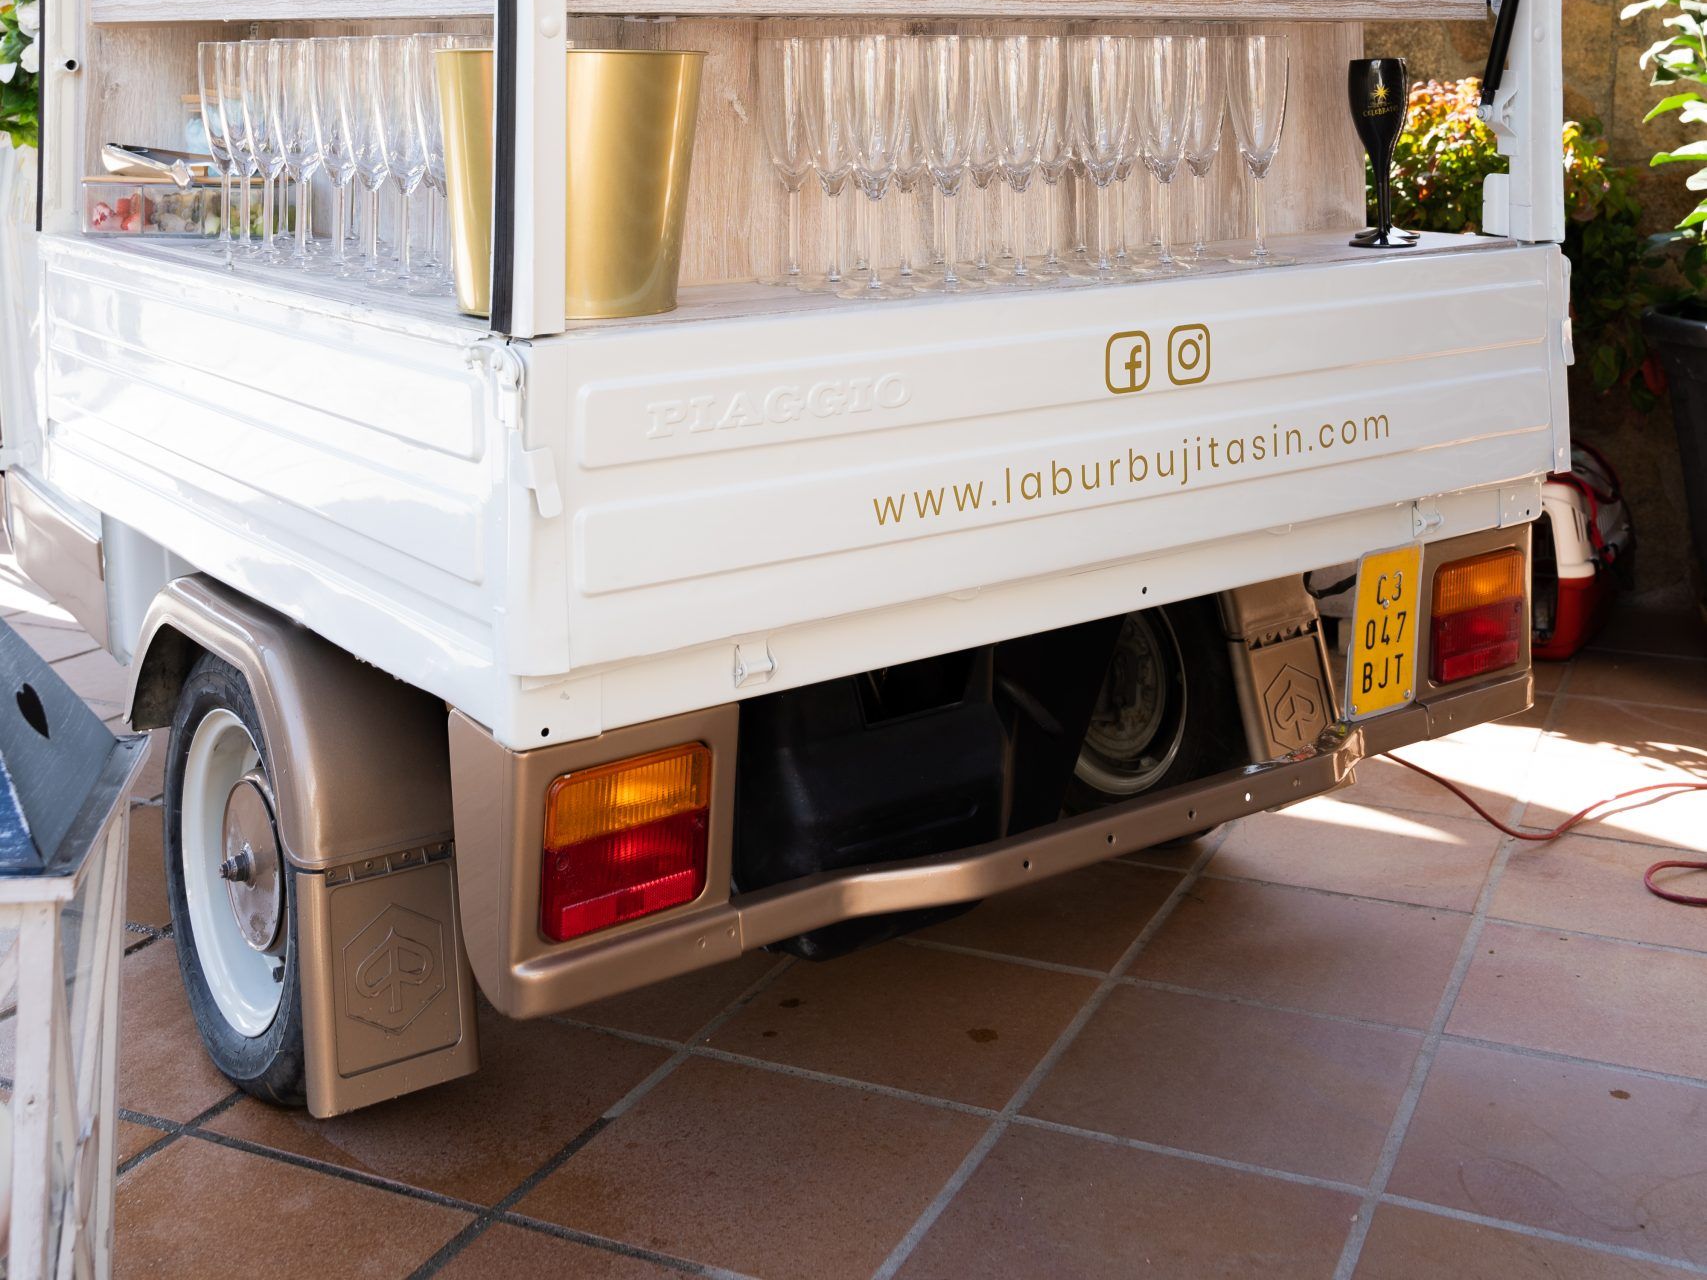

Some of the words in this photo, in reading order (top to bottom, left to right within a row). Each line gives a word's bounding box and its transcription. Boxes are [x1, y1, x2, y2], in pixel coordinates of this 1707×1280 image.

[645, 372, 912, 440] PIAGGIO
[872, 414, 1390, 526] www.laburbujitasin.com
[1365, 611, 1407, 651] 047
[1362, 653, 1404, 694] BJT
